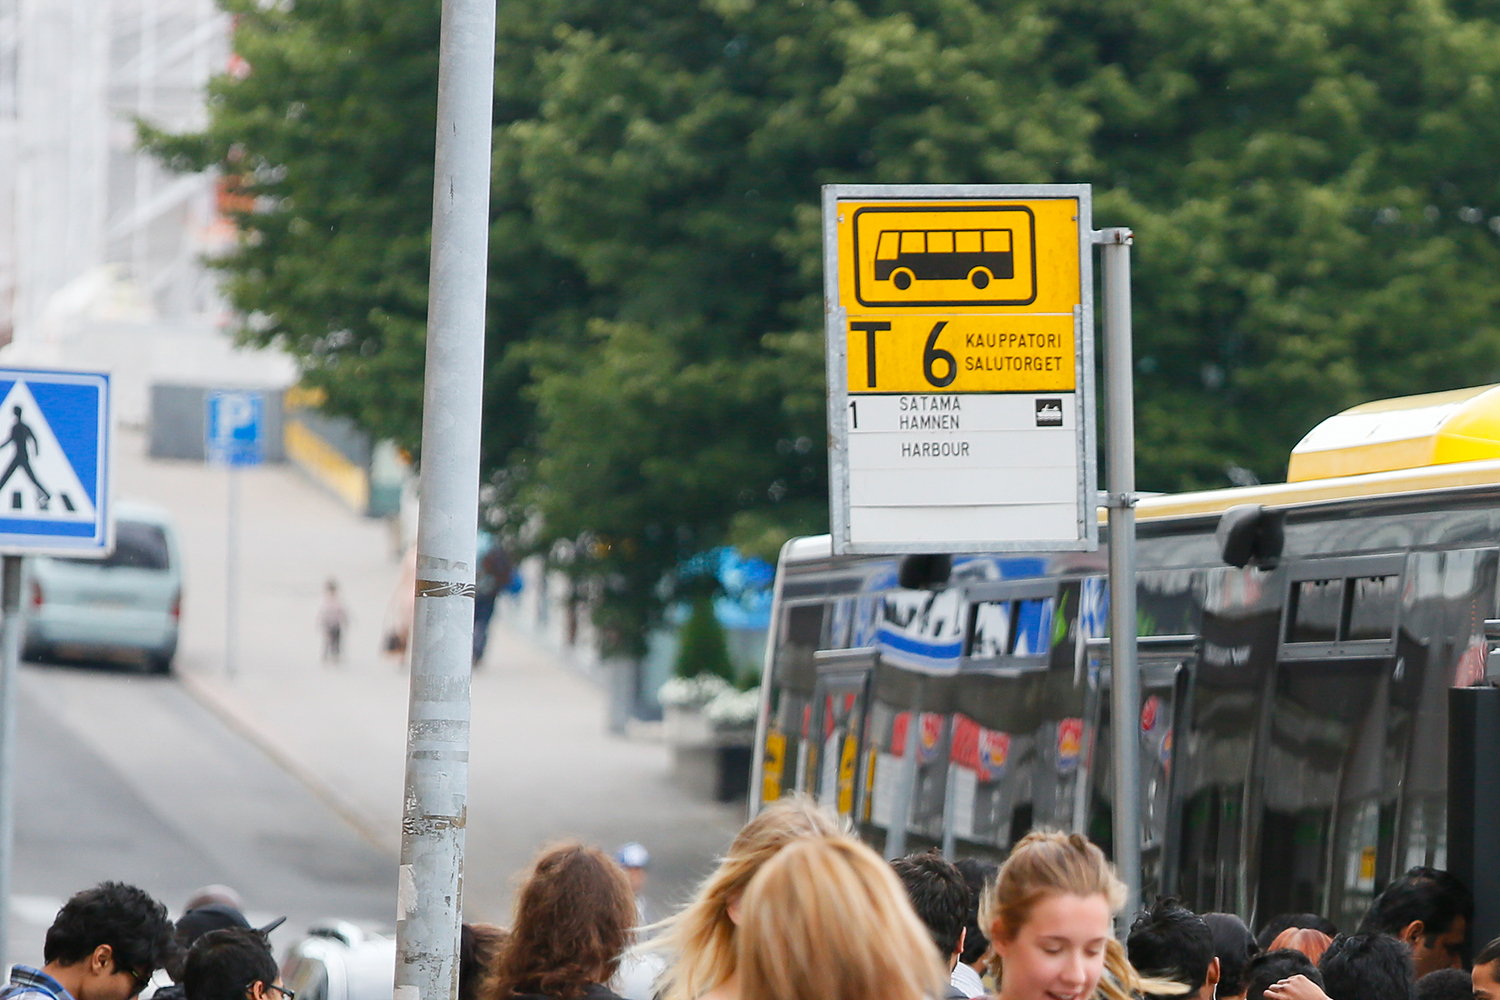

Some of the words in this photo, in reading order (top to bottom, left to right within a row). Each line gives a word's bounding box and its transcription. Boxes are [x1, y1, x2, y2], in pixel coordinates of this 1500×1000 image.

[965, 333, 1062, 349] KAUPPATORI
[850, 321, 891, 388] T
[923, 321, 957, 388] 6
[965, 356, 1062, 371] SALUTORGET
[849, 401, 858, 429] 1
[899, 397, 961, 411] SATAMA
[899, 415, 960, 430] HAMNEN
[901, 441, 970, 457] HARBOUR
